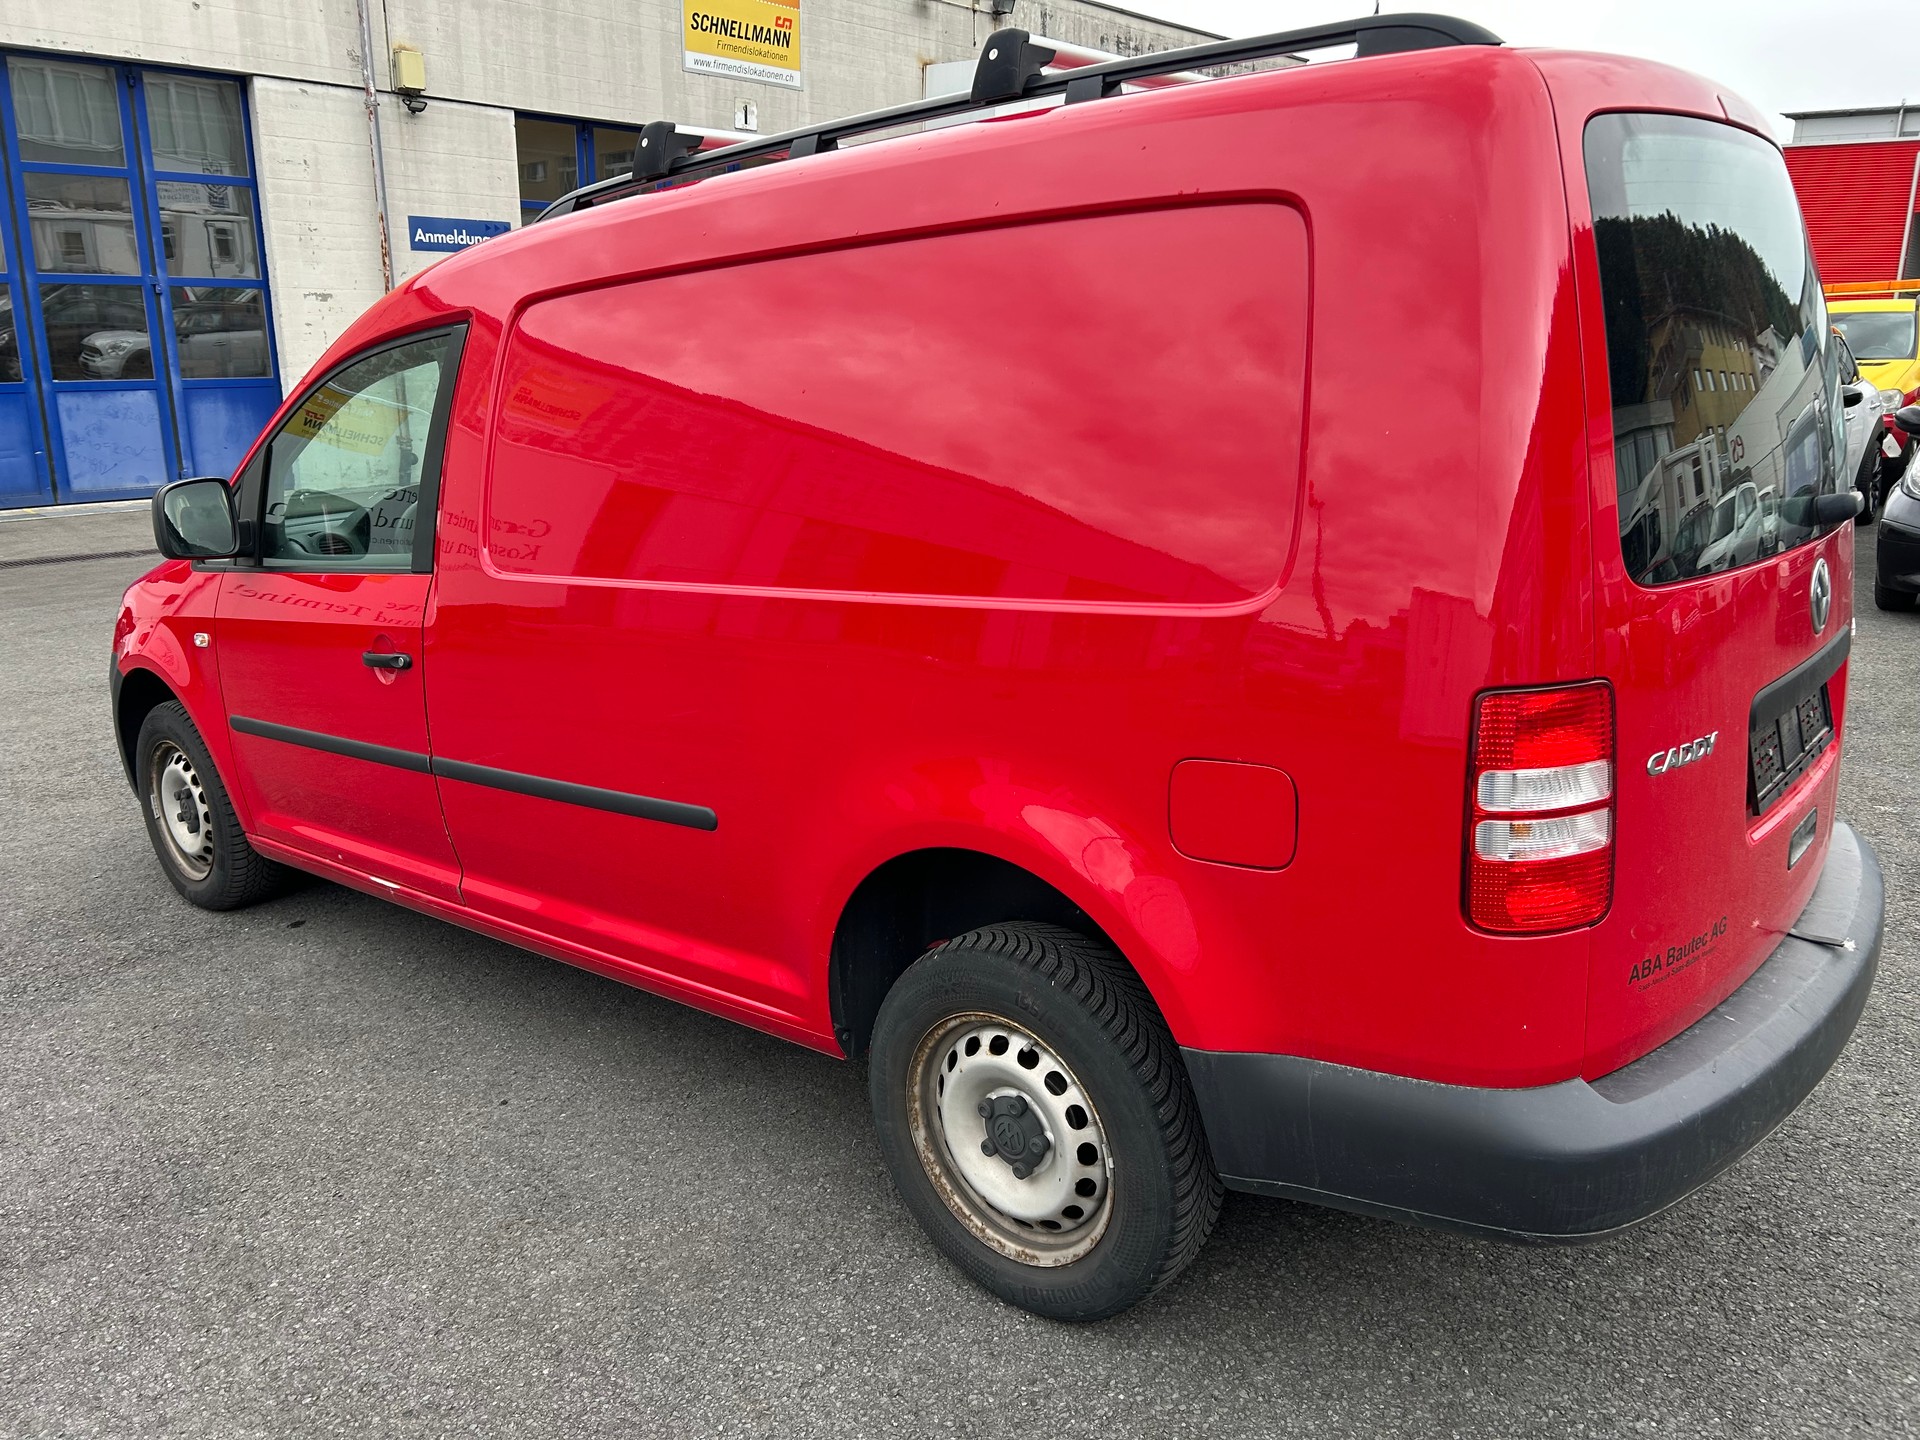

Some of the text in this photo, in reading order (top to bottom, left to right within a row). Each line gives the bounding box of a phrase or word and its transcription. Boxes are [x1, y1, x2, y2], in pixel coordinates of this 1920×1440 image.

[691, 12, 791, 48] SCHNELLMANN
[716, 40, 788, 62] Firmendislokationen
[693, 57, 794, 82] www.firmendislokationen.ch
[1647, 731, 1719, 776] CADDY
[1627, 953, 1662, 985] ABA
[1666, 932, 1709, 968] Bautec
[1709, 917, 1728, 942] AG
